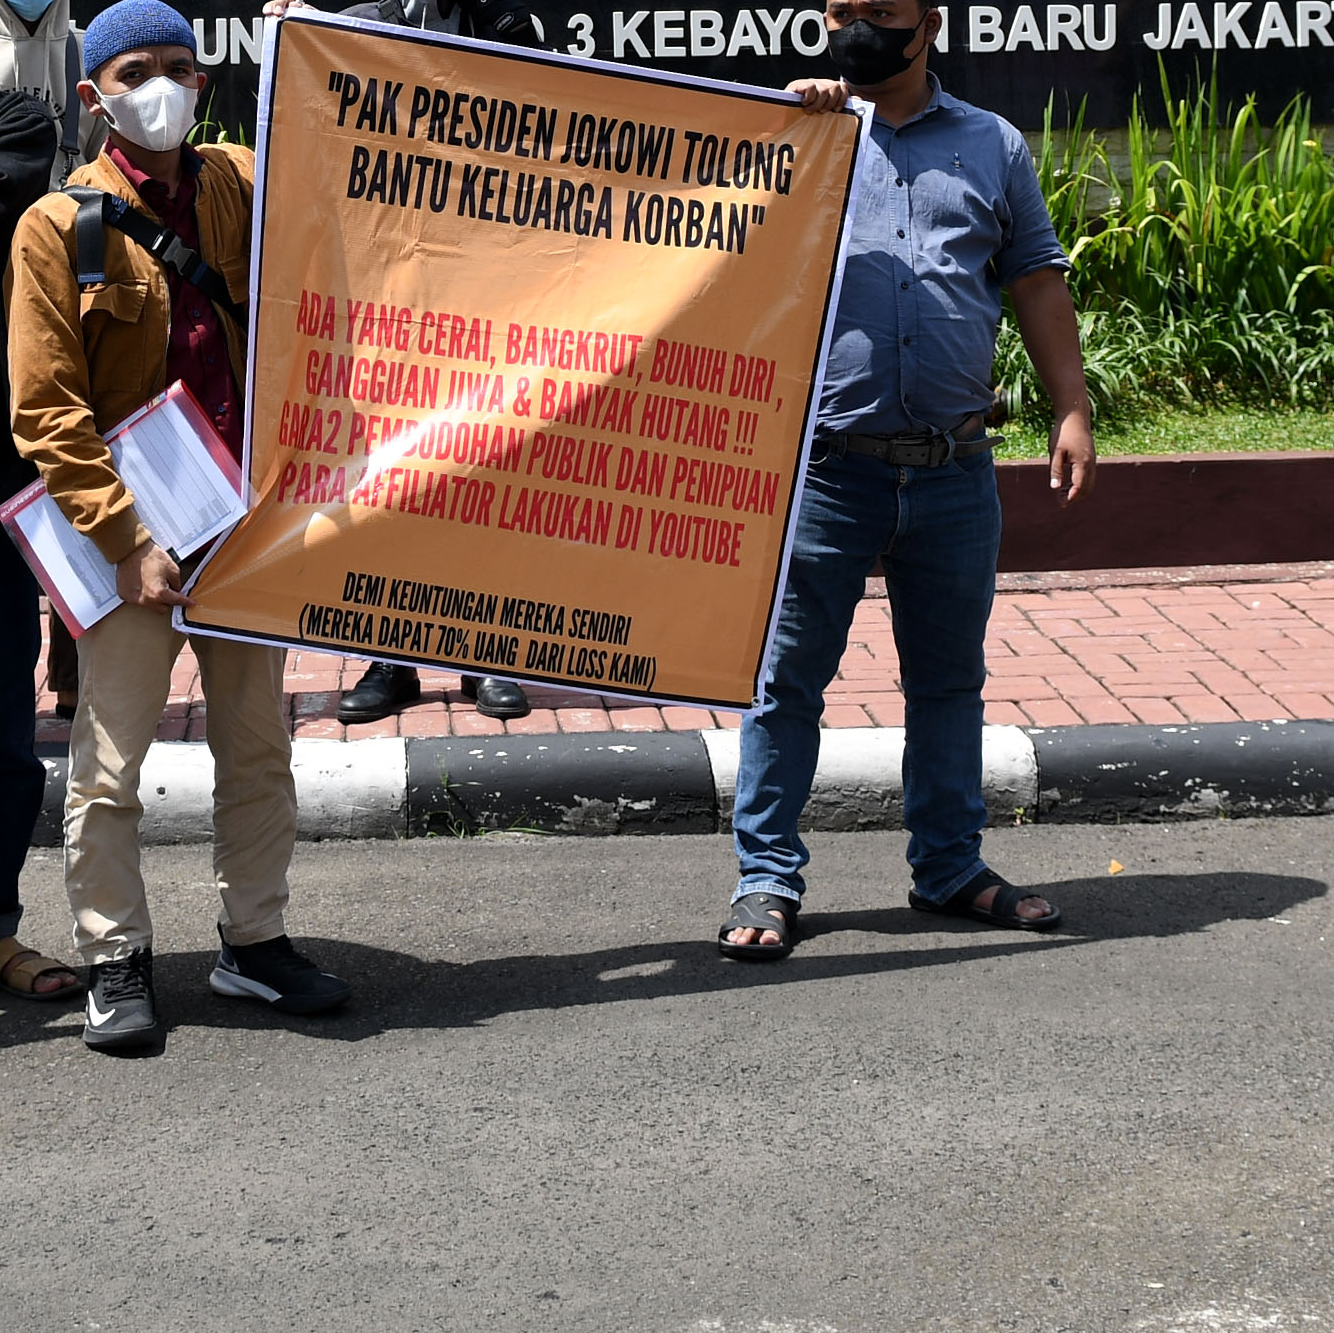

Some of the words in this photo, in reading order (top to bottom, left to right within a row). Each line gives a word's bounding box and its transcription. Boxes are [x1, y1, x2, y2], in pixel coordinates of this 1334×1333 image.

[612, 7, 949, 59] KEBAYO
[968, 3, 1117, 53] BARU
[327, 70, 404, 136] "PAK
[407, 85, 558, 162] PRESIDEN
[559, 111, 676, 181] JOKOWI
[682, 130, 795, 196] TOLONG
[346, 144, 453, 214] BANTU
[457, 163, 612, 240] KELUARGA
[622, 190, 766, 255] KORBAN"
[296, 289, 336, 341] ADA
[346, 299, 413, 352] YANG
[418, 311, 496, 369] CERAI,
[505, 323, 644, 386] BANGKRUT,
[650, 338, 728, 395] BUNUH
[728, 353, 777, 403] DIRI
[278, 398, 342, 455] GARA2
[525, 431, 614, 489] PUBLIK
[614, 446, 668, 498] DAN
[669, 456, 781, 515] PENIPUAN
[305, 349, 440, 409] GANGGUAN
[444, 368, 504, 415] JIWA
[512, 375, 532, 418] &
[539, 377, 640, 435] BANYAK
[638, 393, 731, 453] HUTANG
[732, 409, 759, 457] !!!
[276, 457, 345, 504] PARA
[352, 467, 497, 527] AFFILIATOR
[498, 484, 614, 547] LAKUKAN
[614, 504, 644, 552] DI
[647, 508, 746, 568] YOUTUBE
[298, 604, 374, 646] (MEREKA
[376, 615, 436, 654] DAPAT
[435, 624, 470, 660] 70%
[473, 630, 520, 667] UANG
[524, 638, 566, 675] DARI
[565, 645, 608, 680] LOSS
[607, 651, 656, 691] KAMI)
[341, 571, 387, 608] DEMI
[386, 578, 499, 625] KEUNTUNGAN
[498, 596, 566, 637] MEREKA
[567, 608, 633, 646] SENDIRI
